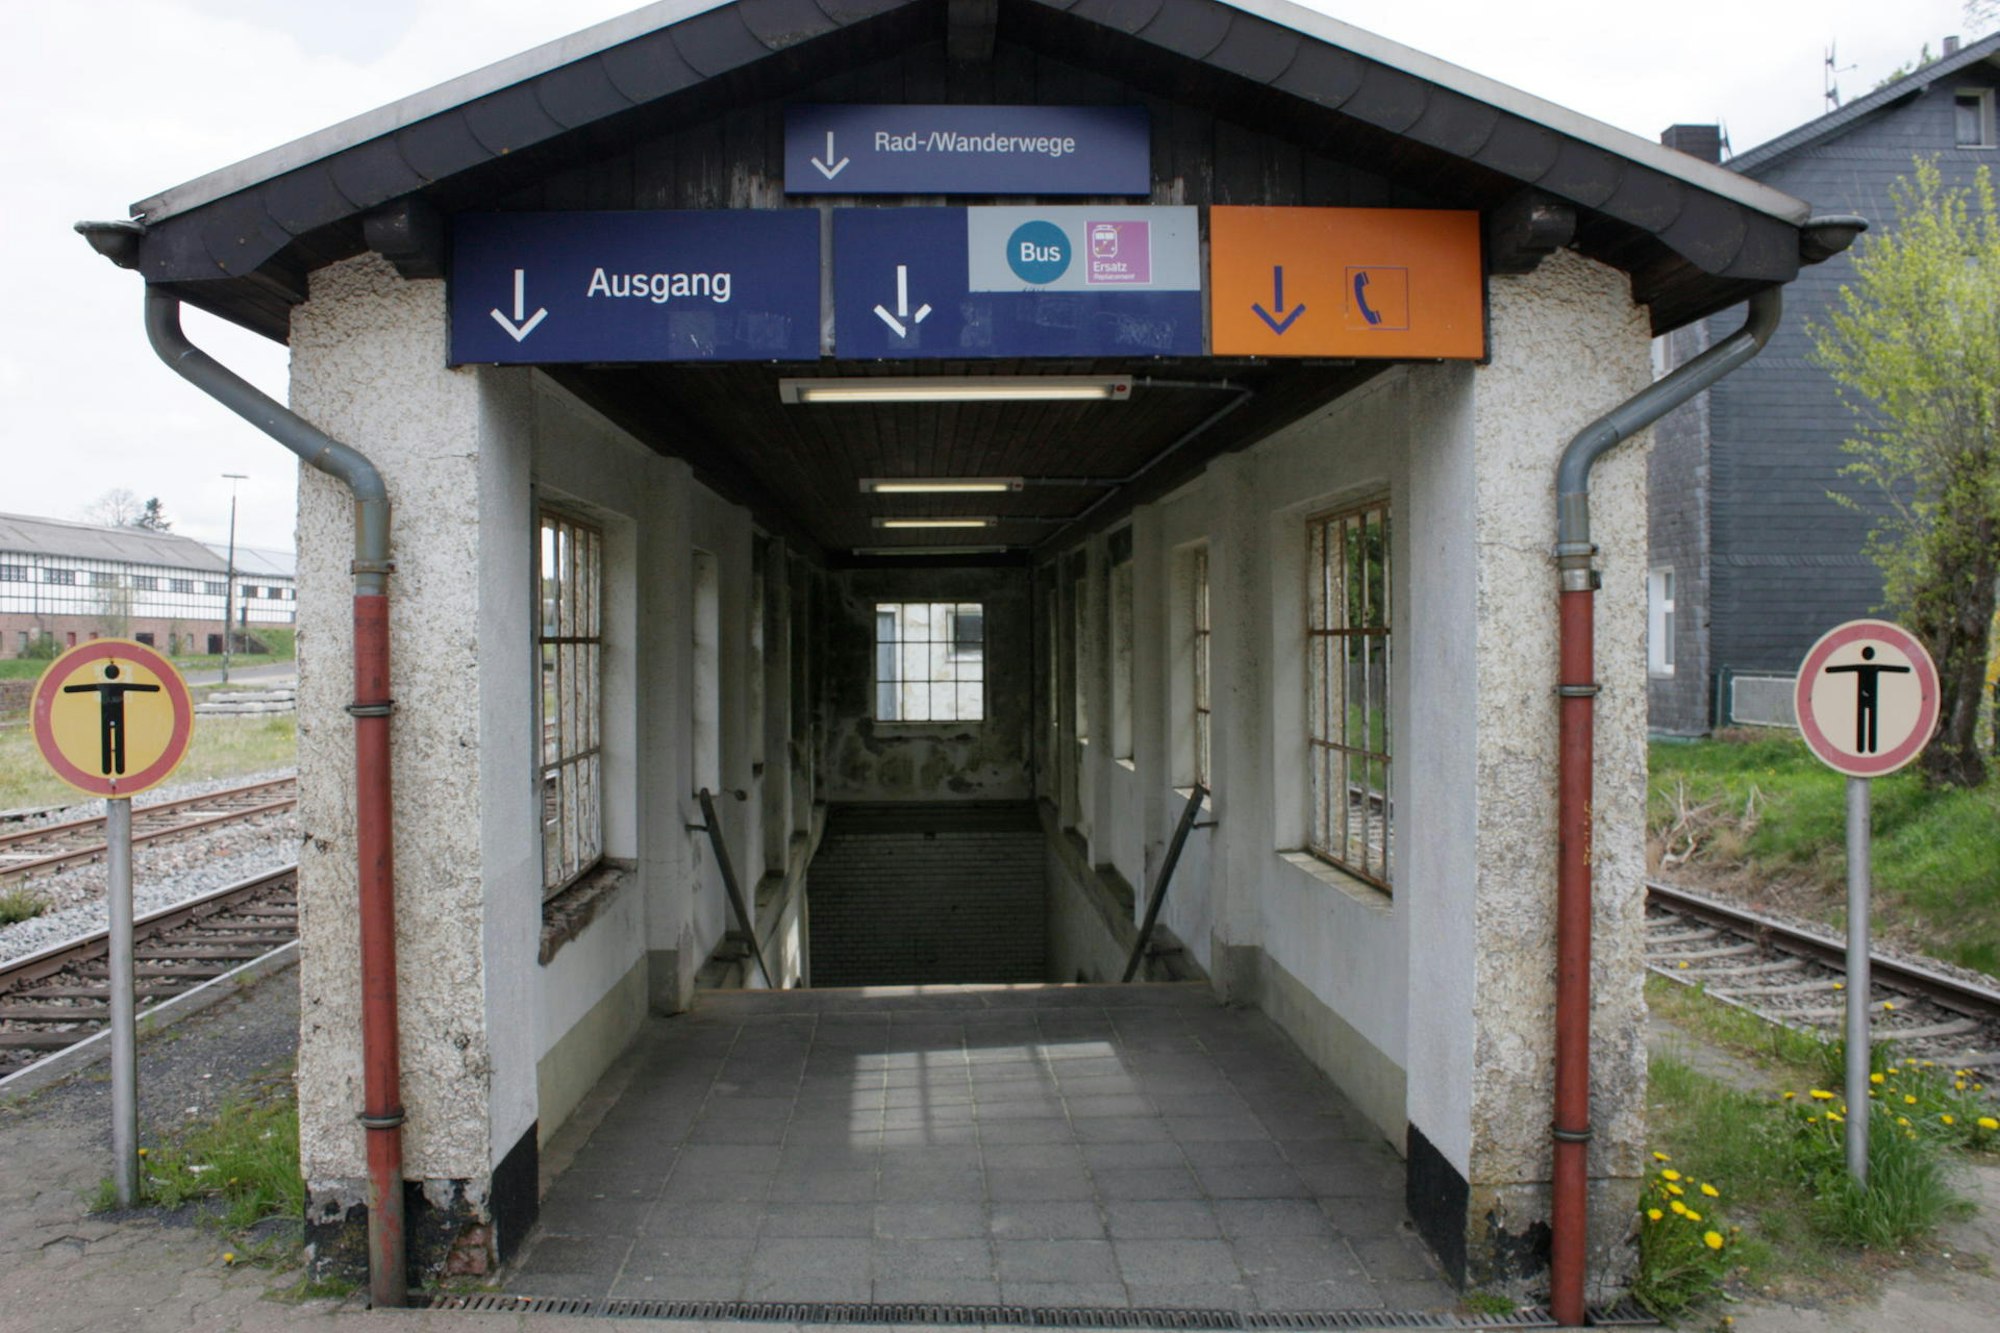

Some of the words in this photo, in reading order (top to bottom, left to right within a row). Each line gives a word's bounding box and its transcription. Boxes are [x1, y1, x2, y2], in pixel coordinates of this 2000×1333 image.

[875, 132, 1075, 157] Rad-/Wanderwege
[1020, 242, 1062, 263] Bus
[1093, 261, 1128, 272] Ersatz
[587, 268, 731, 304] Ausgang
